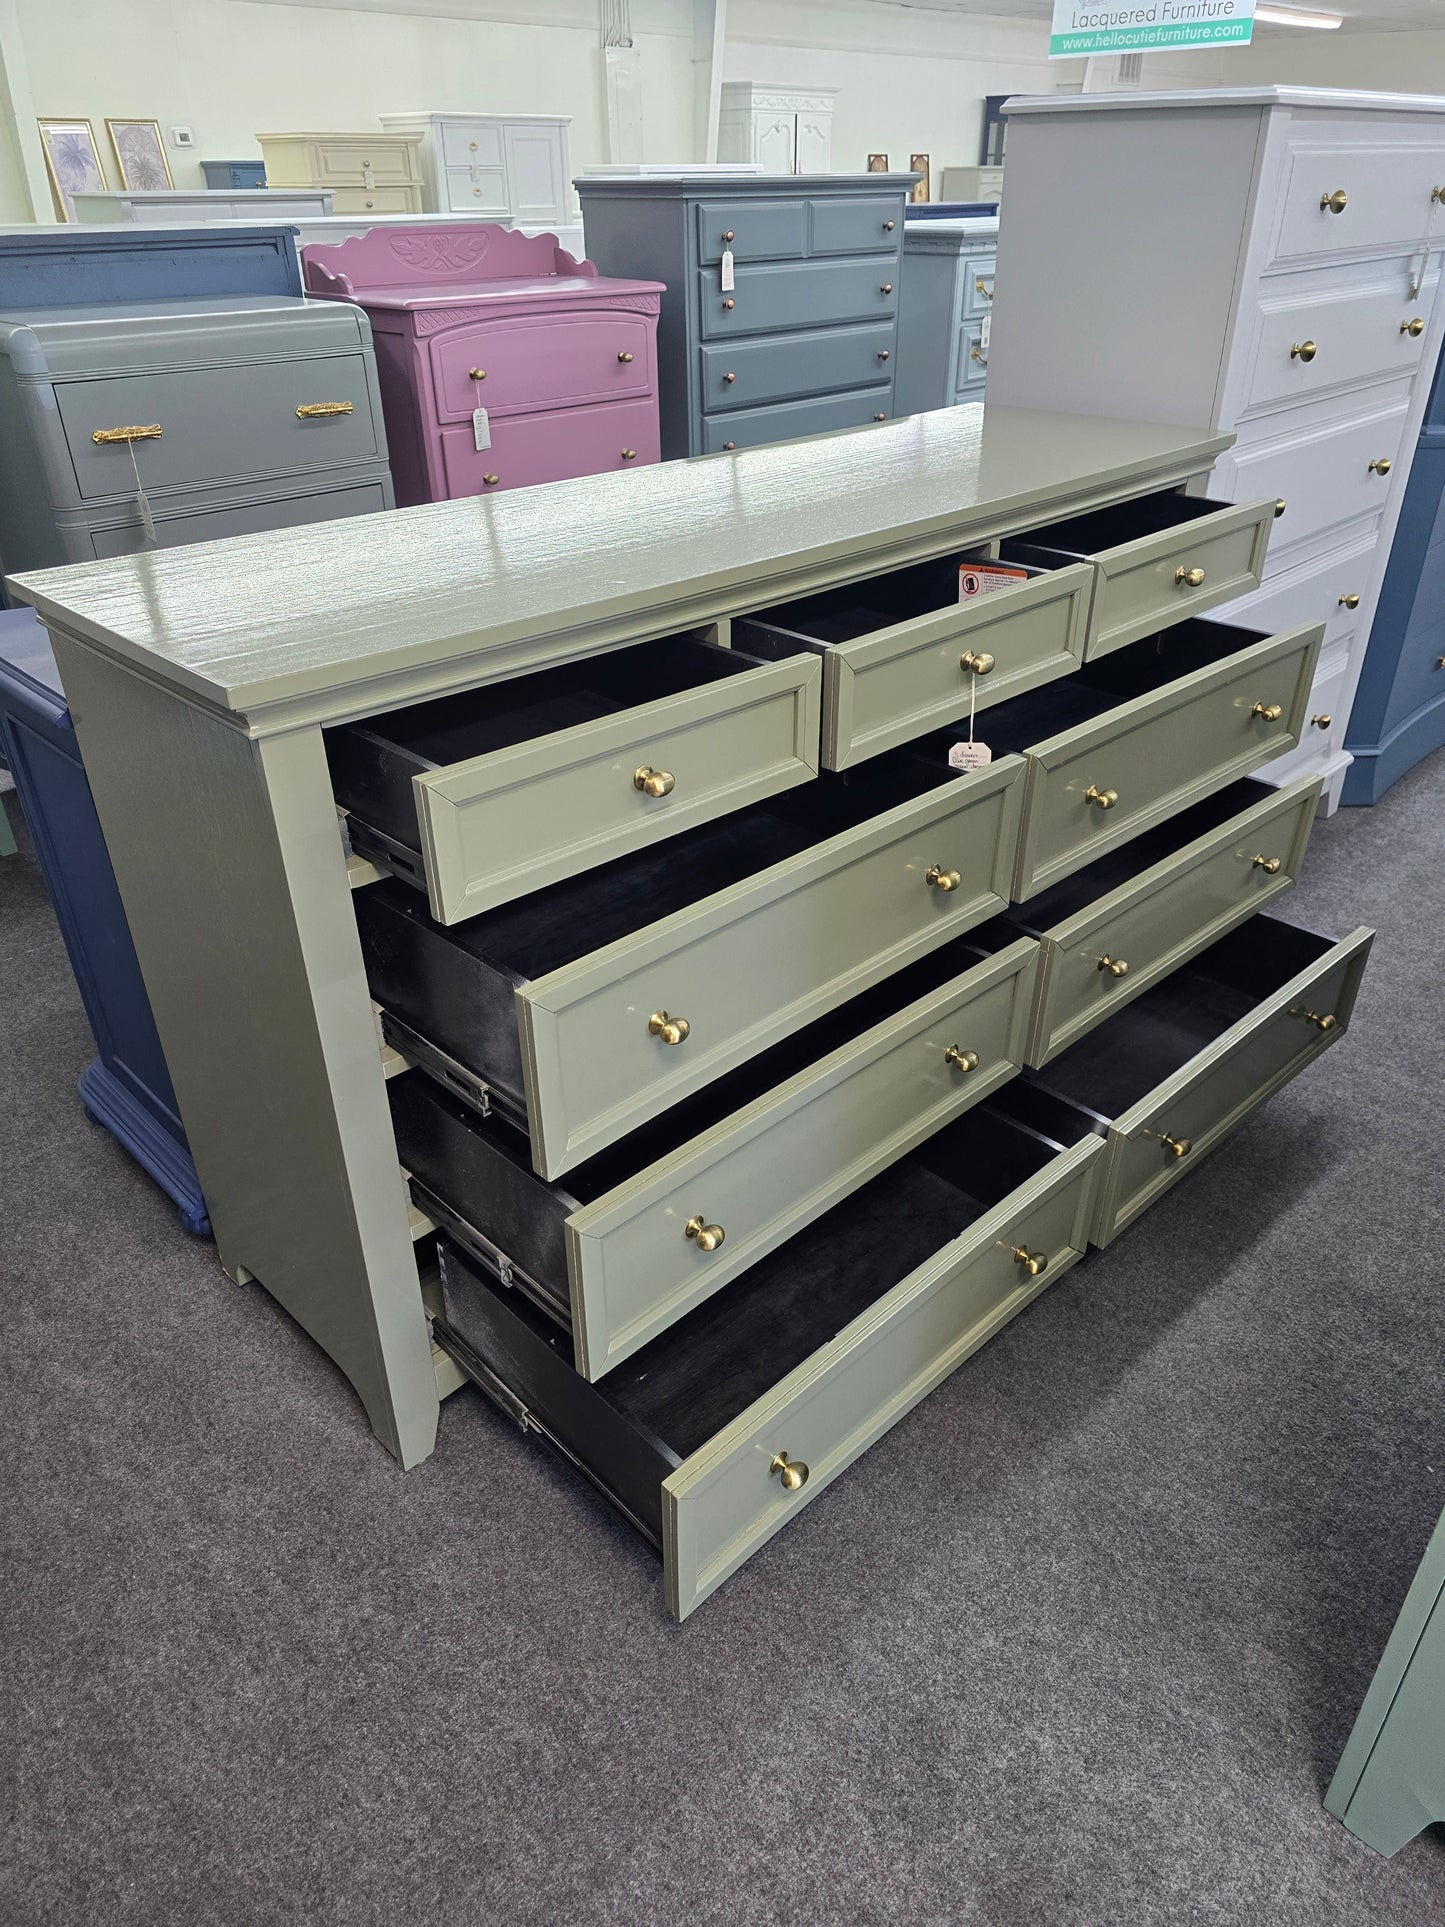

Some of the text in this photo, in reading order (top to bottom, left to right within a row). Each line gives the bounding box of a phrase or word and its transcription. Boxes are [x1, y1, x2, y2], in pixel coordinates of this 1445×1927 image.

[1071, 0, 1235, 31] Lacquered Furniture
[1062, 24, 1243, 50] www.hellocutiefurniture.com
